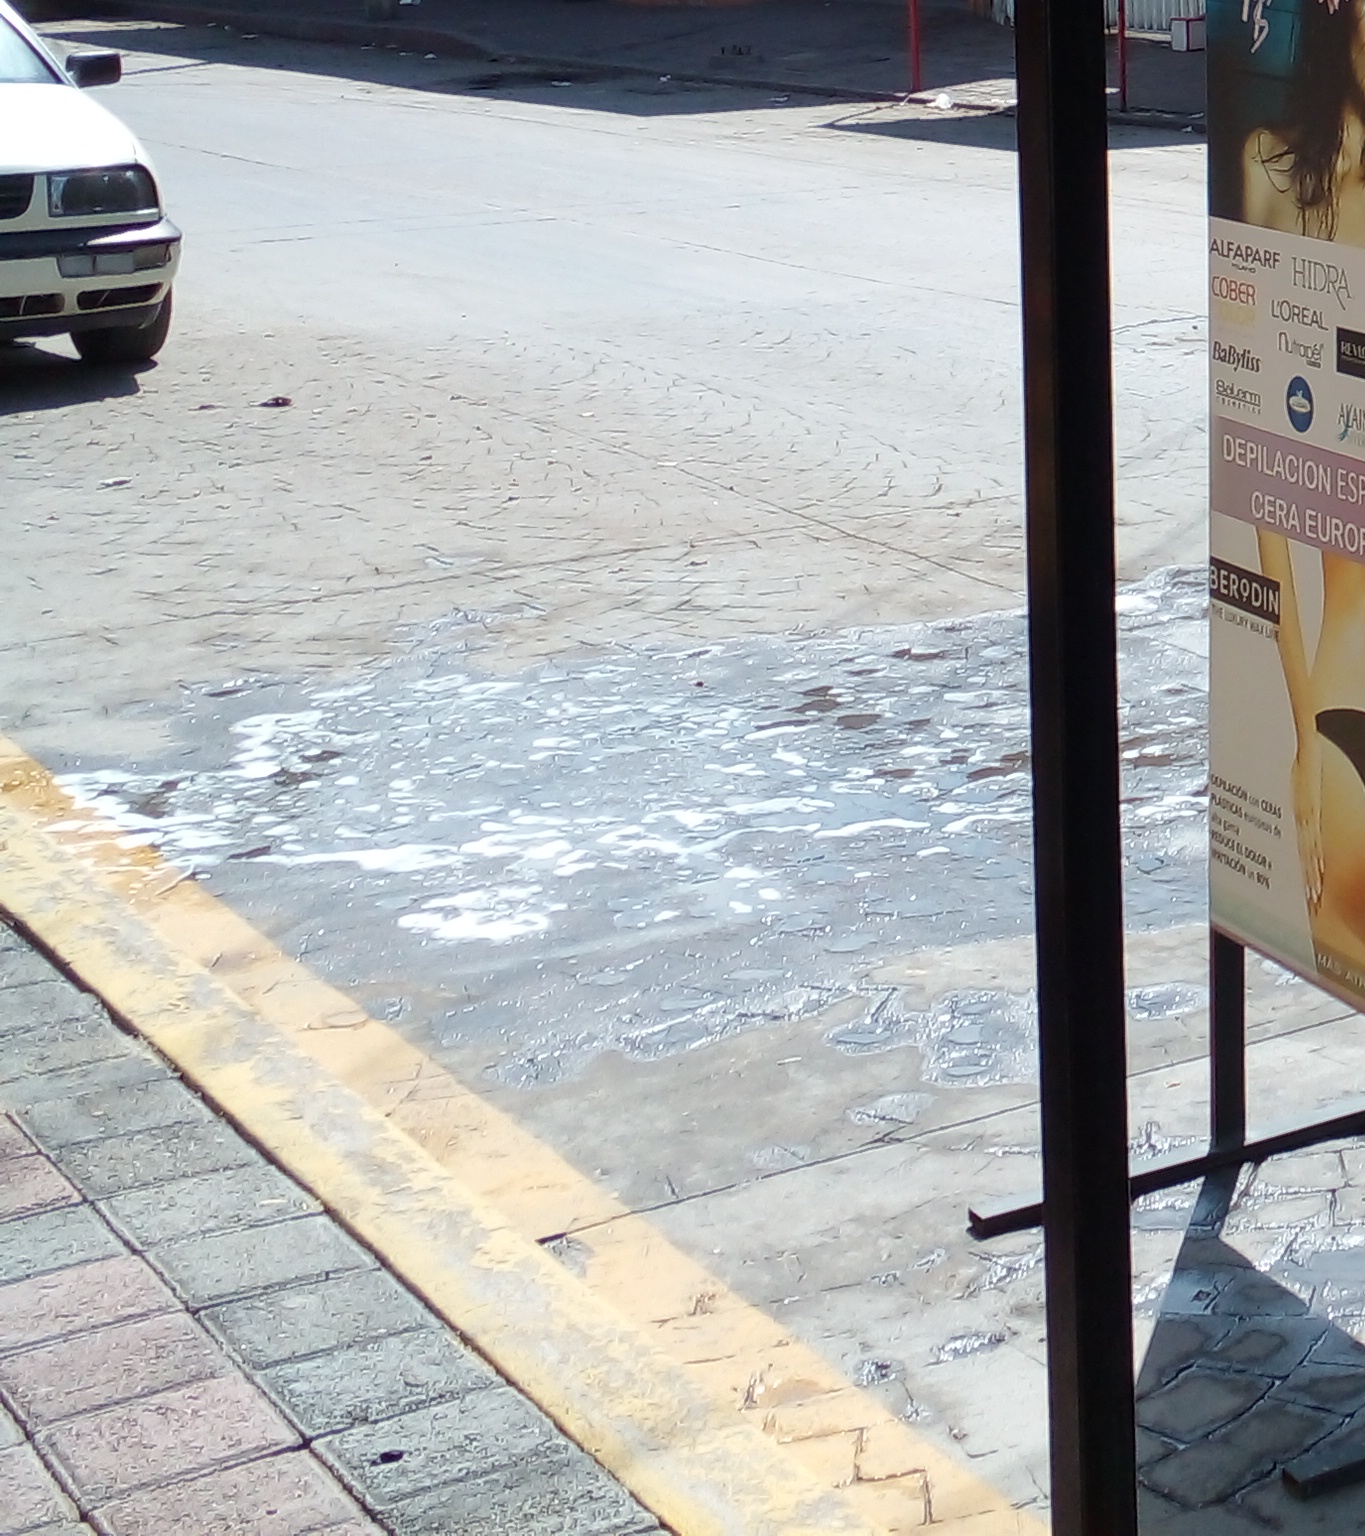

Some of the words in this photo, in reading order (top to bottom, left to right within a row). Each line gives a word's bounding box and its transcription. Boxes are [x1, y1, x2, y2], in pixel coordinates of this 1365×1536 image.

[1210, 238, 1281, 269] ALFAPARF
[1212, 276, 1256, 306] COBER
[1291, 256, 1352, 311] HIDRA
[1212, 340, 1262, 373] BaByliss
[1223, 433, 1332, 497] DEPILACION
[1251, 491, 1301, 534] CERA
[1209, 565, 1279, 616] BERODIN
